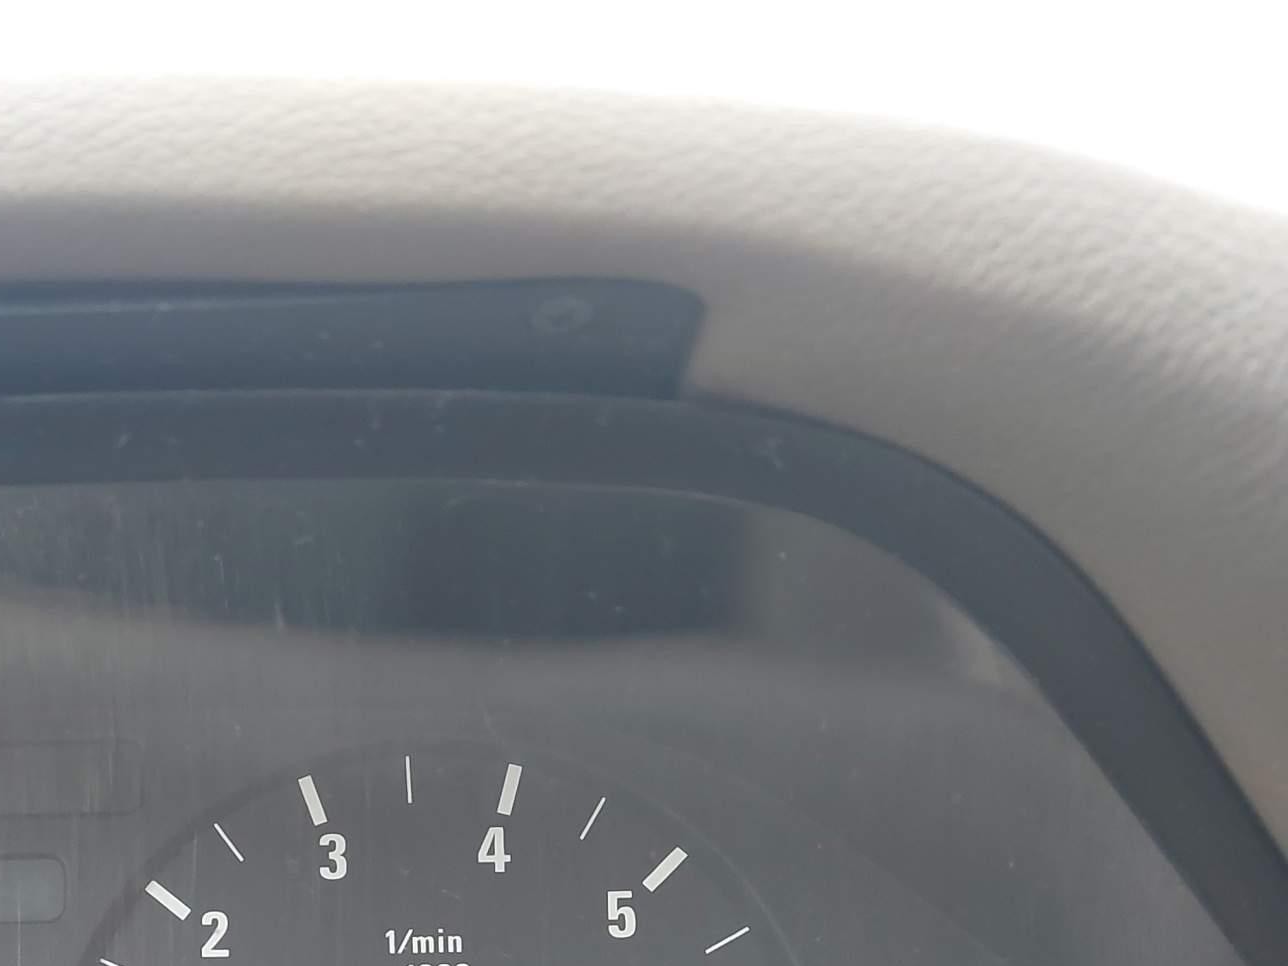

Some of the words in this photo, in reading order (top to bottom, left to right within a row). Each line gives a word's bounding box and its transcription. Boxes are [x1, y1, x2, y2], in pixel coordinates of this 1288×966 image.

[319, 834, 348, 880] 3
[478, 827, 510, 872] 4
[200, 911, 230, 958] 2
[607, 890, 636, 938] 5
[384, 929, 463, 956] 1/min
